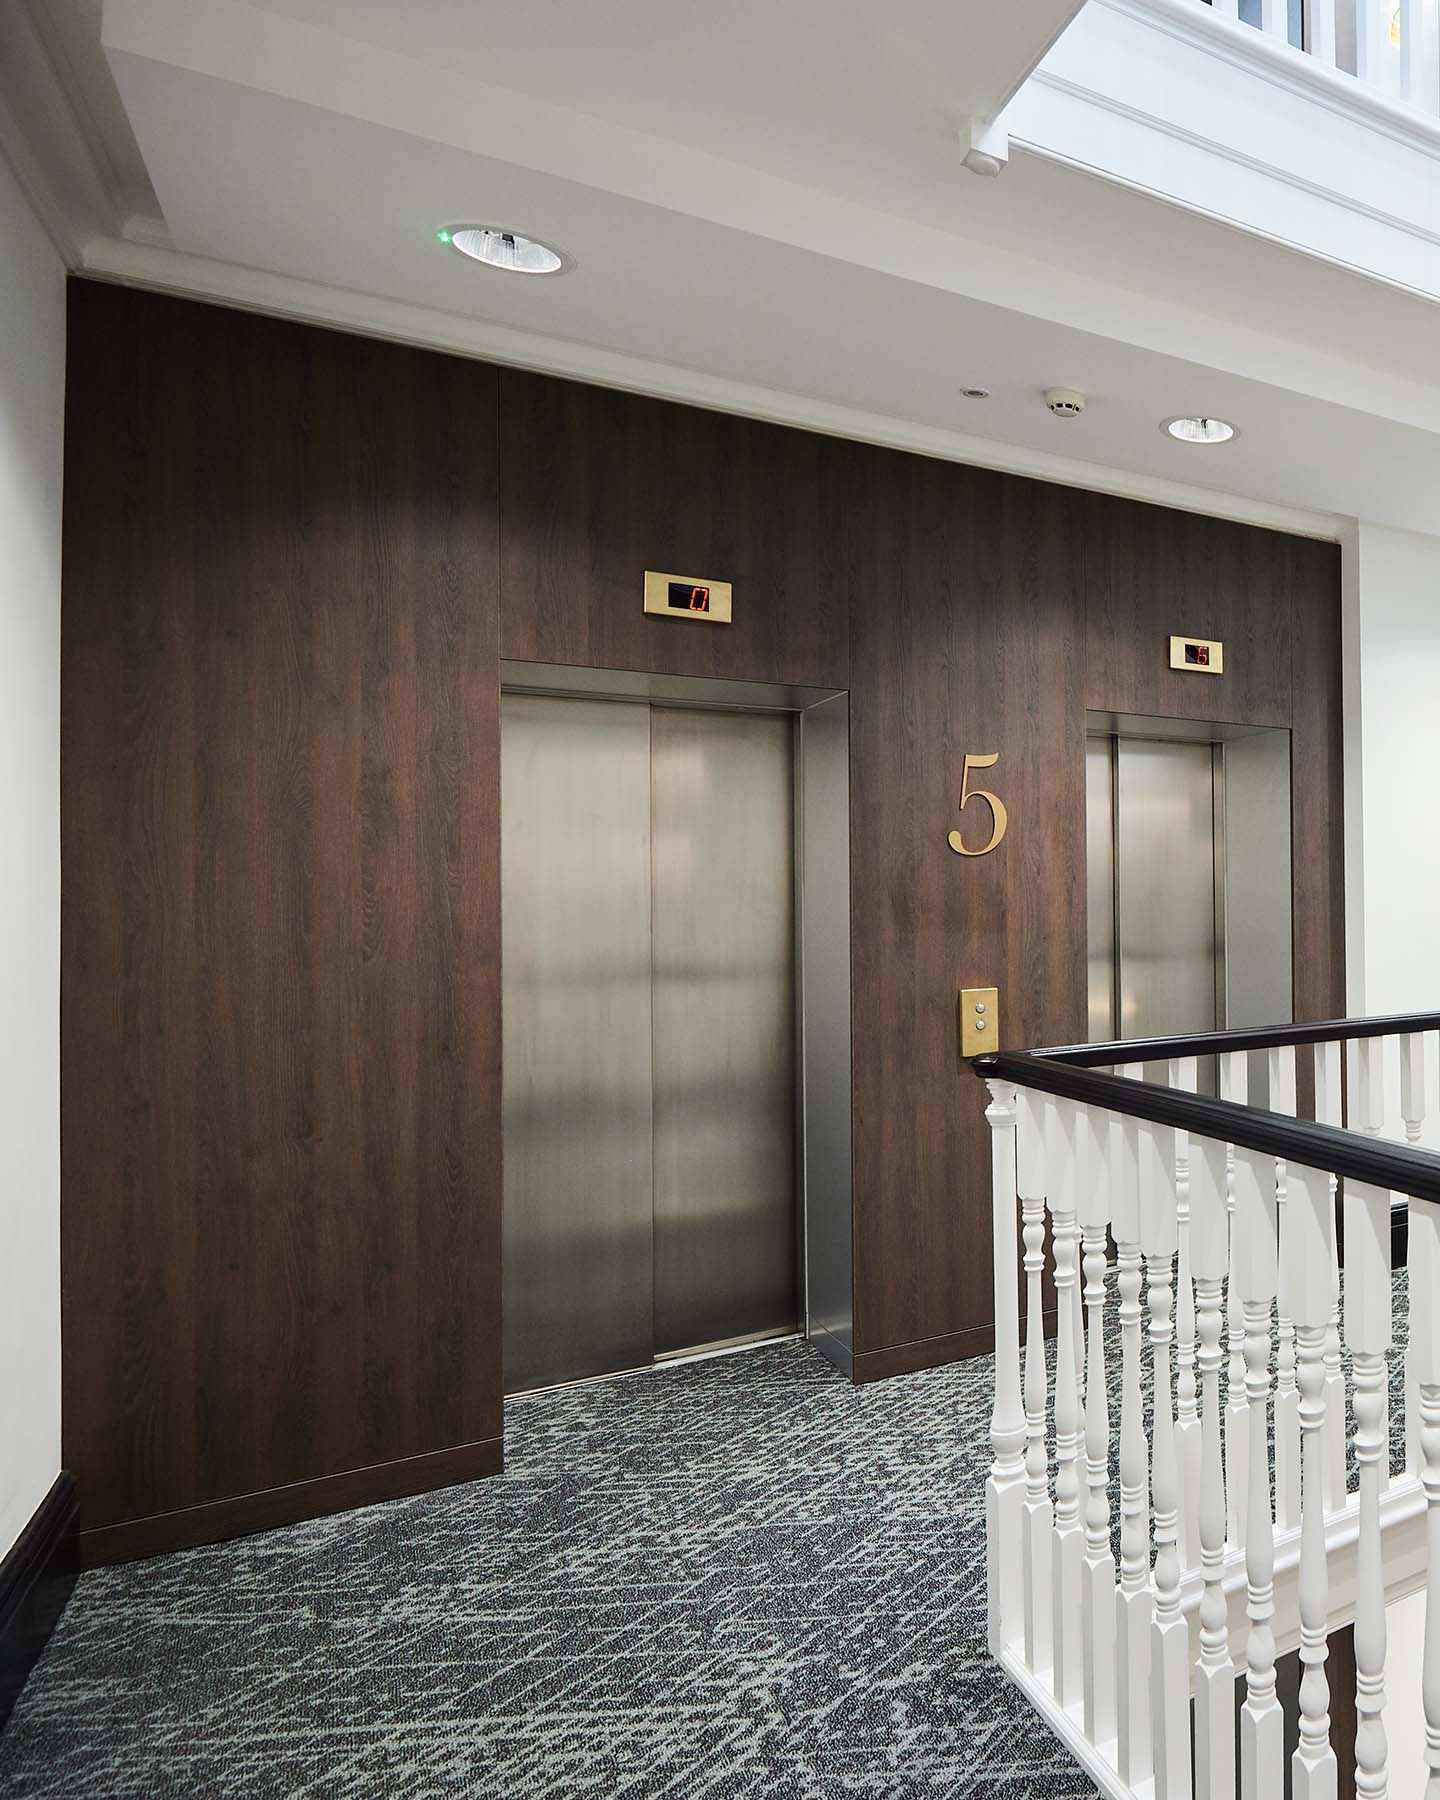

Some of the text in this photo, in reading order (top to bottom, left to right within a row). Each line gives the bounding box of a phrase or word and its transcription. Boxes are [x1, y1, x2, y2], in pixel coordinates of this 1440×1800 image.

[689, 587, 709, 611] 0
[1196, 646, 1208, 665] 6
[947, 752, 1007, 856] 5
